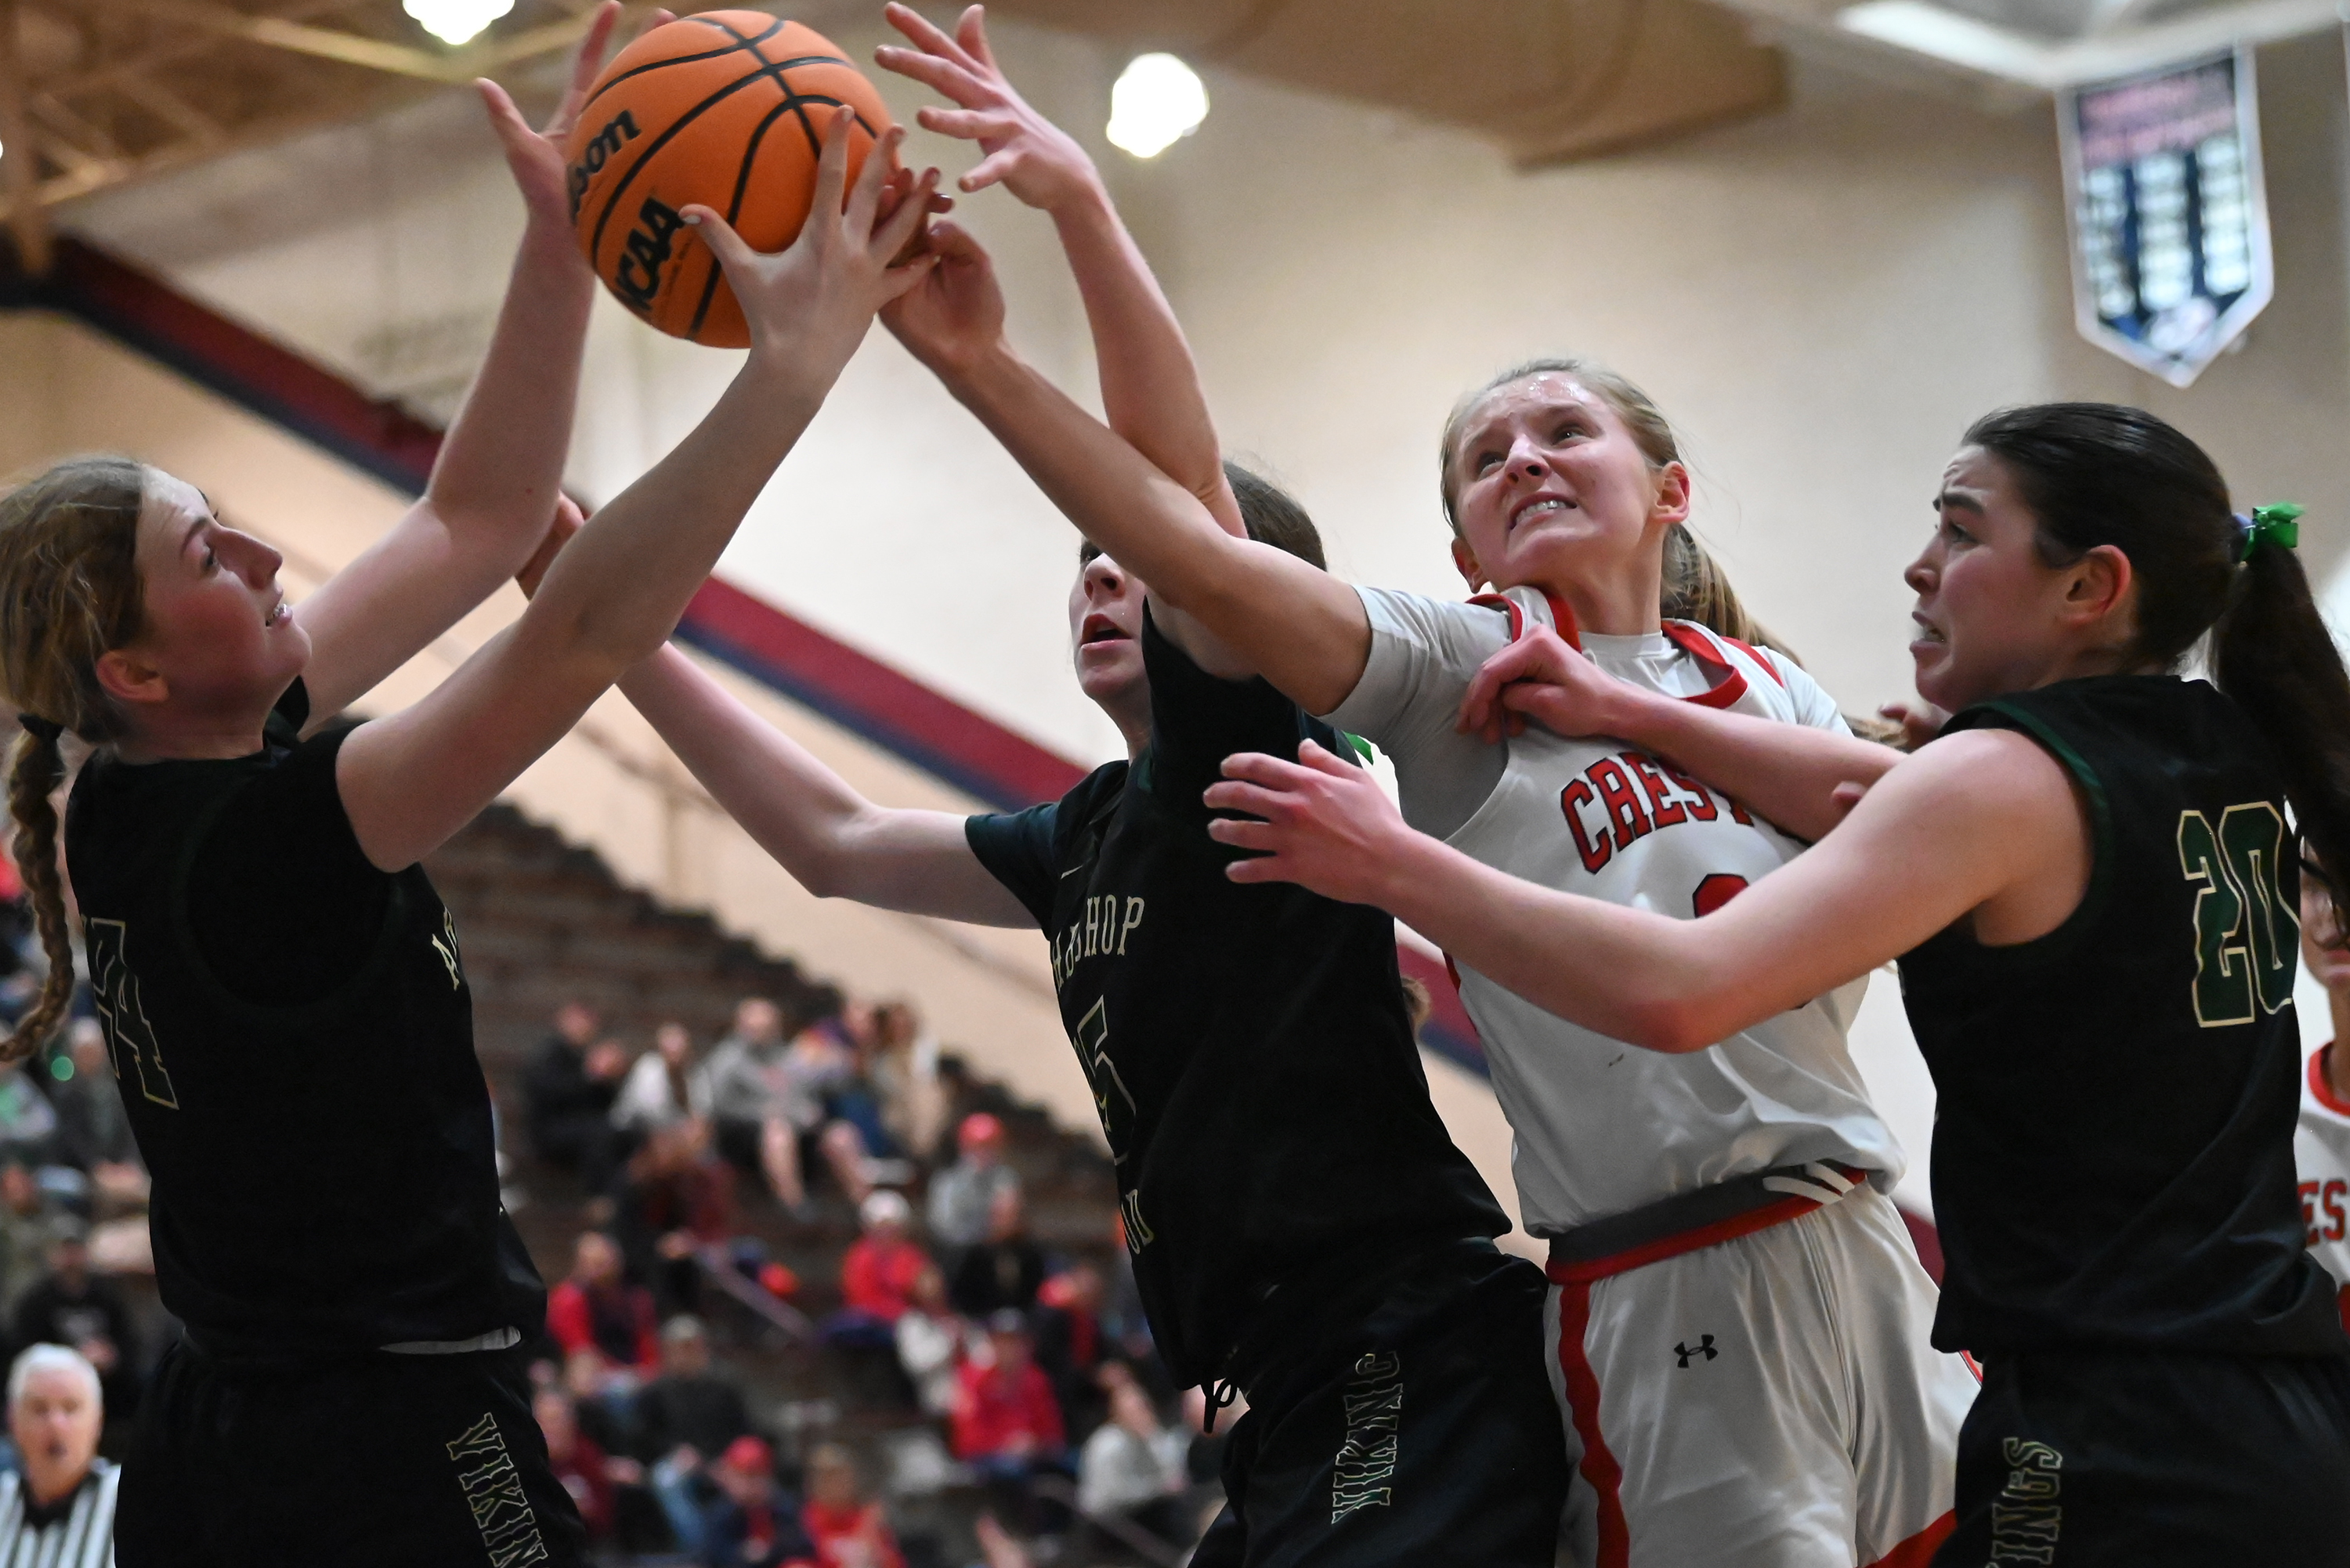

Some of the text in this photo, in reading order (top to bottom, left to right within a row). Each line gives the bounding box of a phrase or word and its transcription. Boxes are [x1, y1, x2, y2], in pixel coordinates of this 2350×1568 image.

[2177, 800, 2300, 1028] 20
[446, 1411, 549, 1568] VIKIN
[1985, 1436, 2063, 1568] INGS
